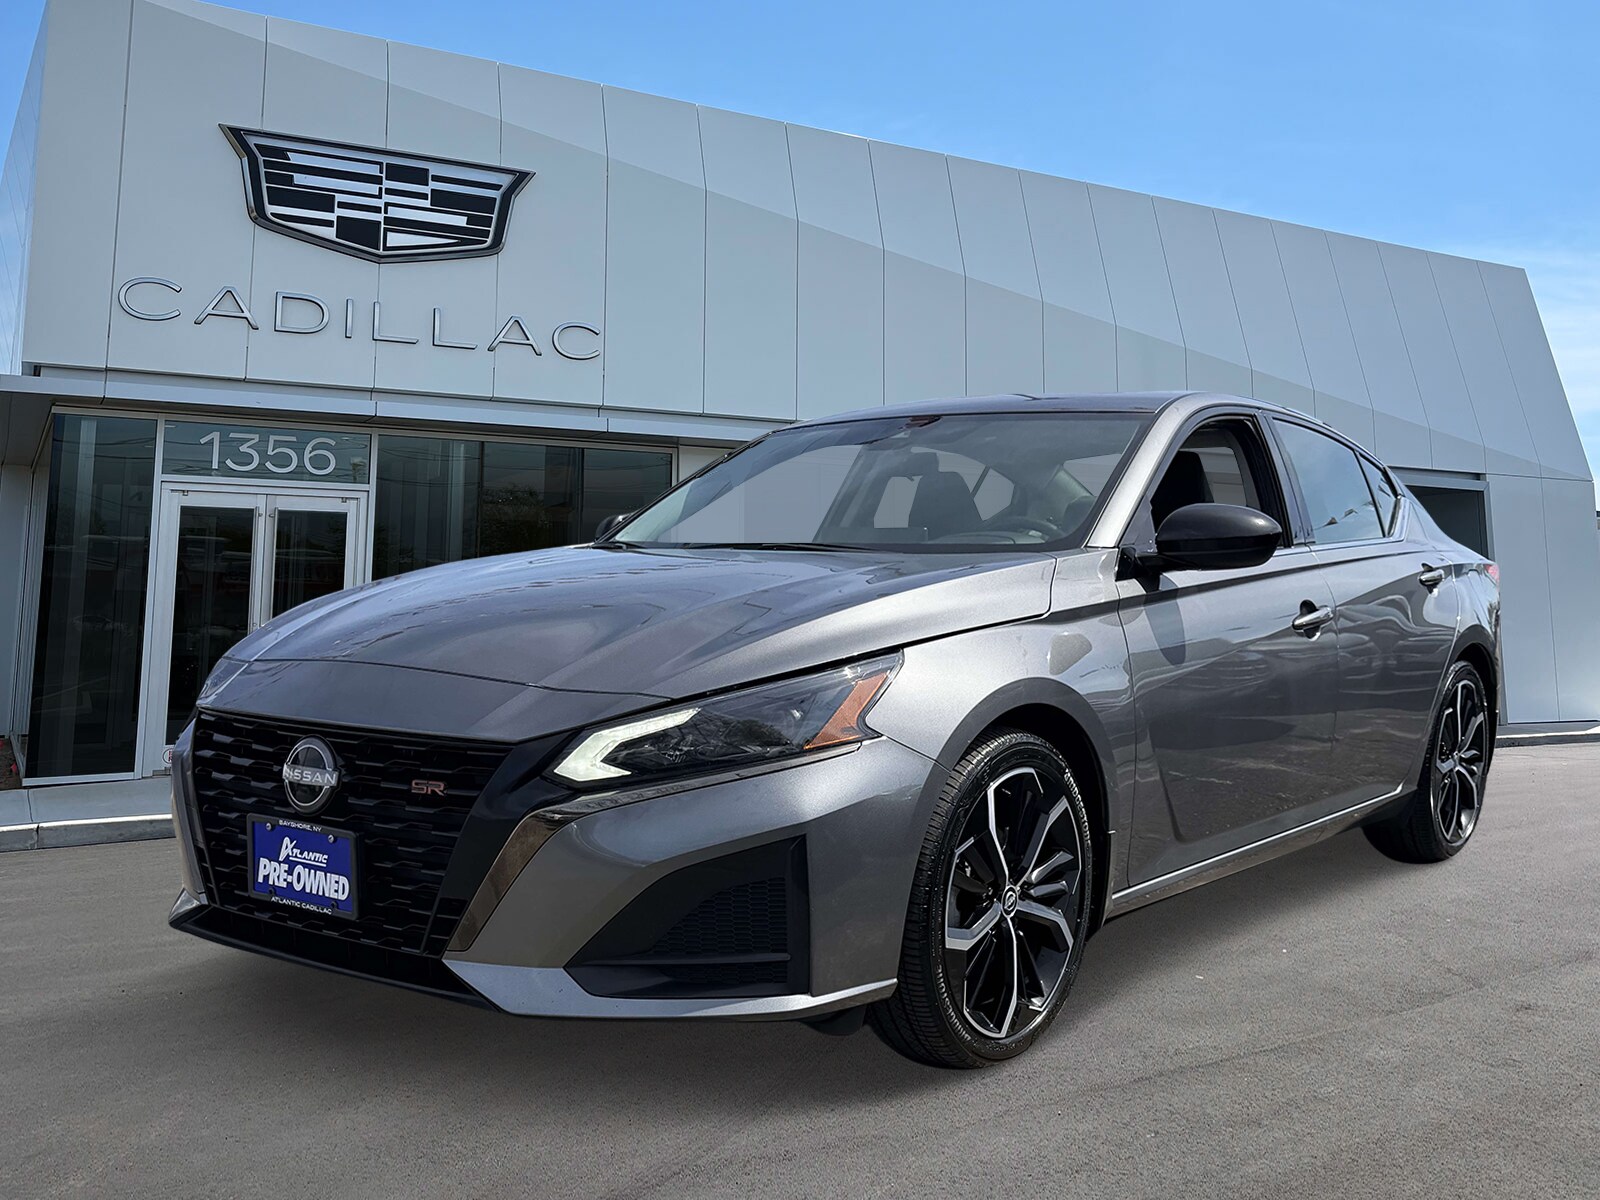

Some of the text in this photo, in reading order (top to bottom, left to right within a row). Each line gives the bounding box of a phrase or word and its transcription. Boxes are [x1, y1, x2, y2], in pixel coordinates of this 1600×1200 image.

[117, 276, 601, 361] CADILLAC
[199, 431, 336, 476] 1356
[283, 766, 336, 785] NISSAN
[411, 779, 445, 796] SR
[257, 857, 349, 901] PRE-OWNED
[270, 896, 332, 915] ATLANTIC CADILLAC
